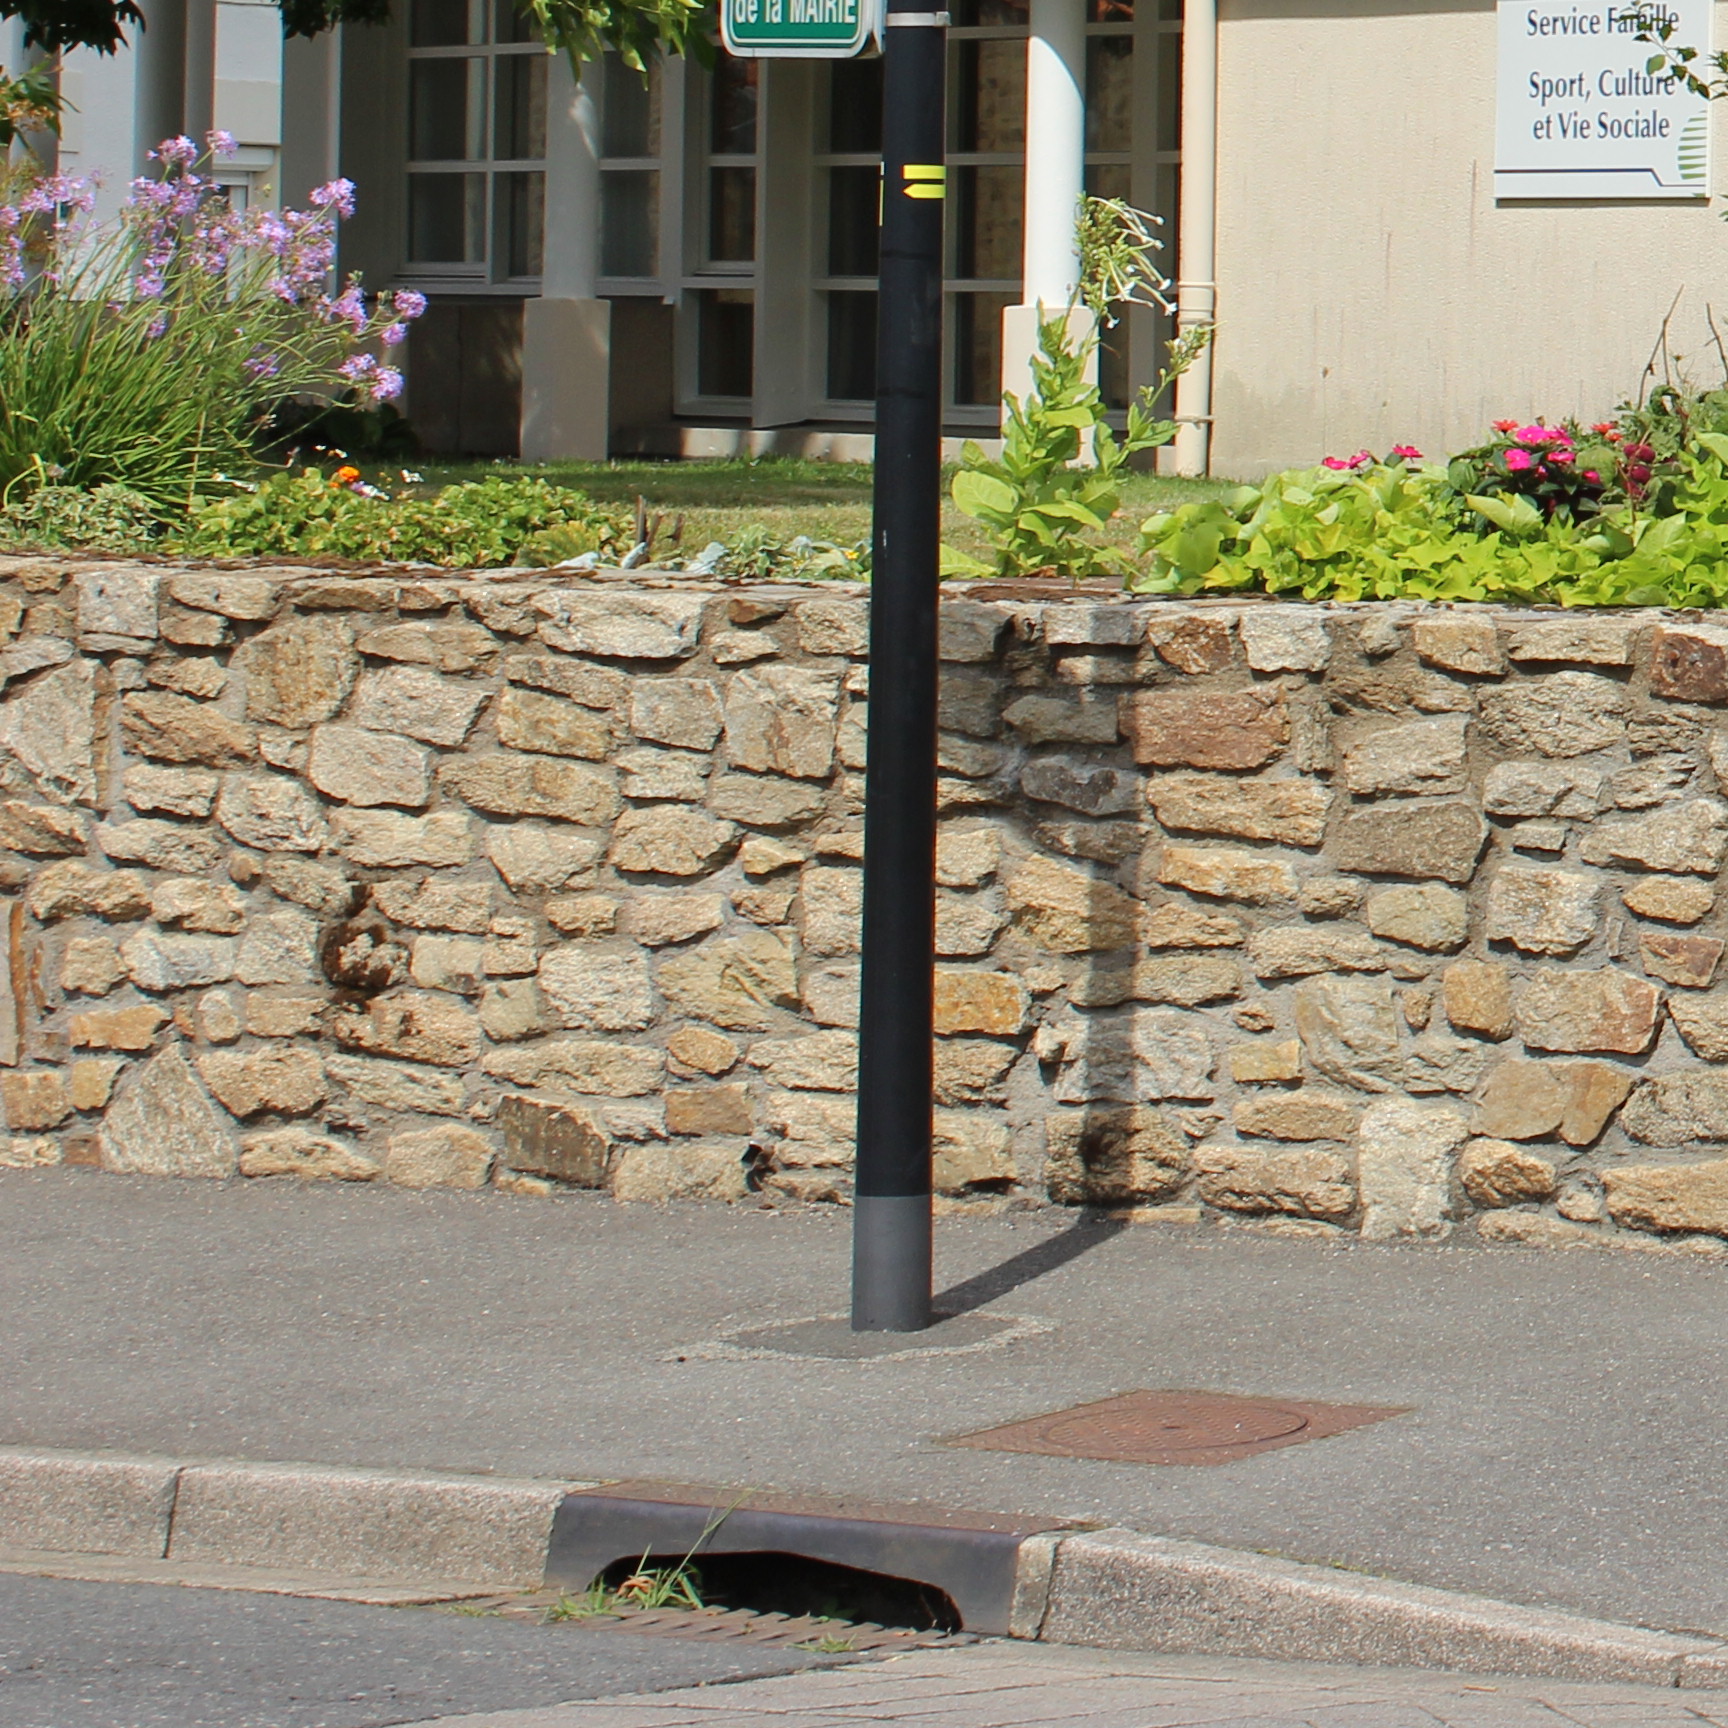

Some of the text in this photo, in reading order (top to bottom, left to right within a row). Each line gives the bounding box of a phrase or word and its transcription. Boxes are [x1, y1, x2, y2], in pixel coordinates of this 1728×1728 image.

[1526, 6, 1600, 36] Service
[1529, 68, 1676, 107] Sport, Culture
[1533, 109, 1670, 139] et Vie Sociale
